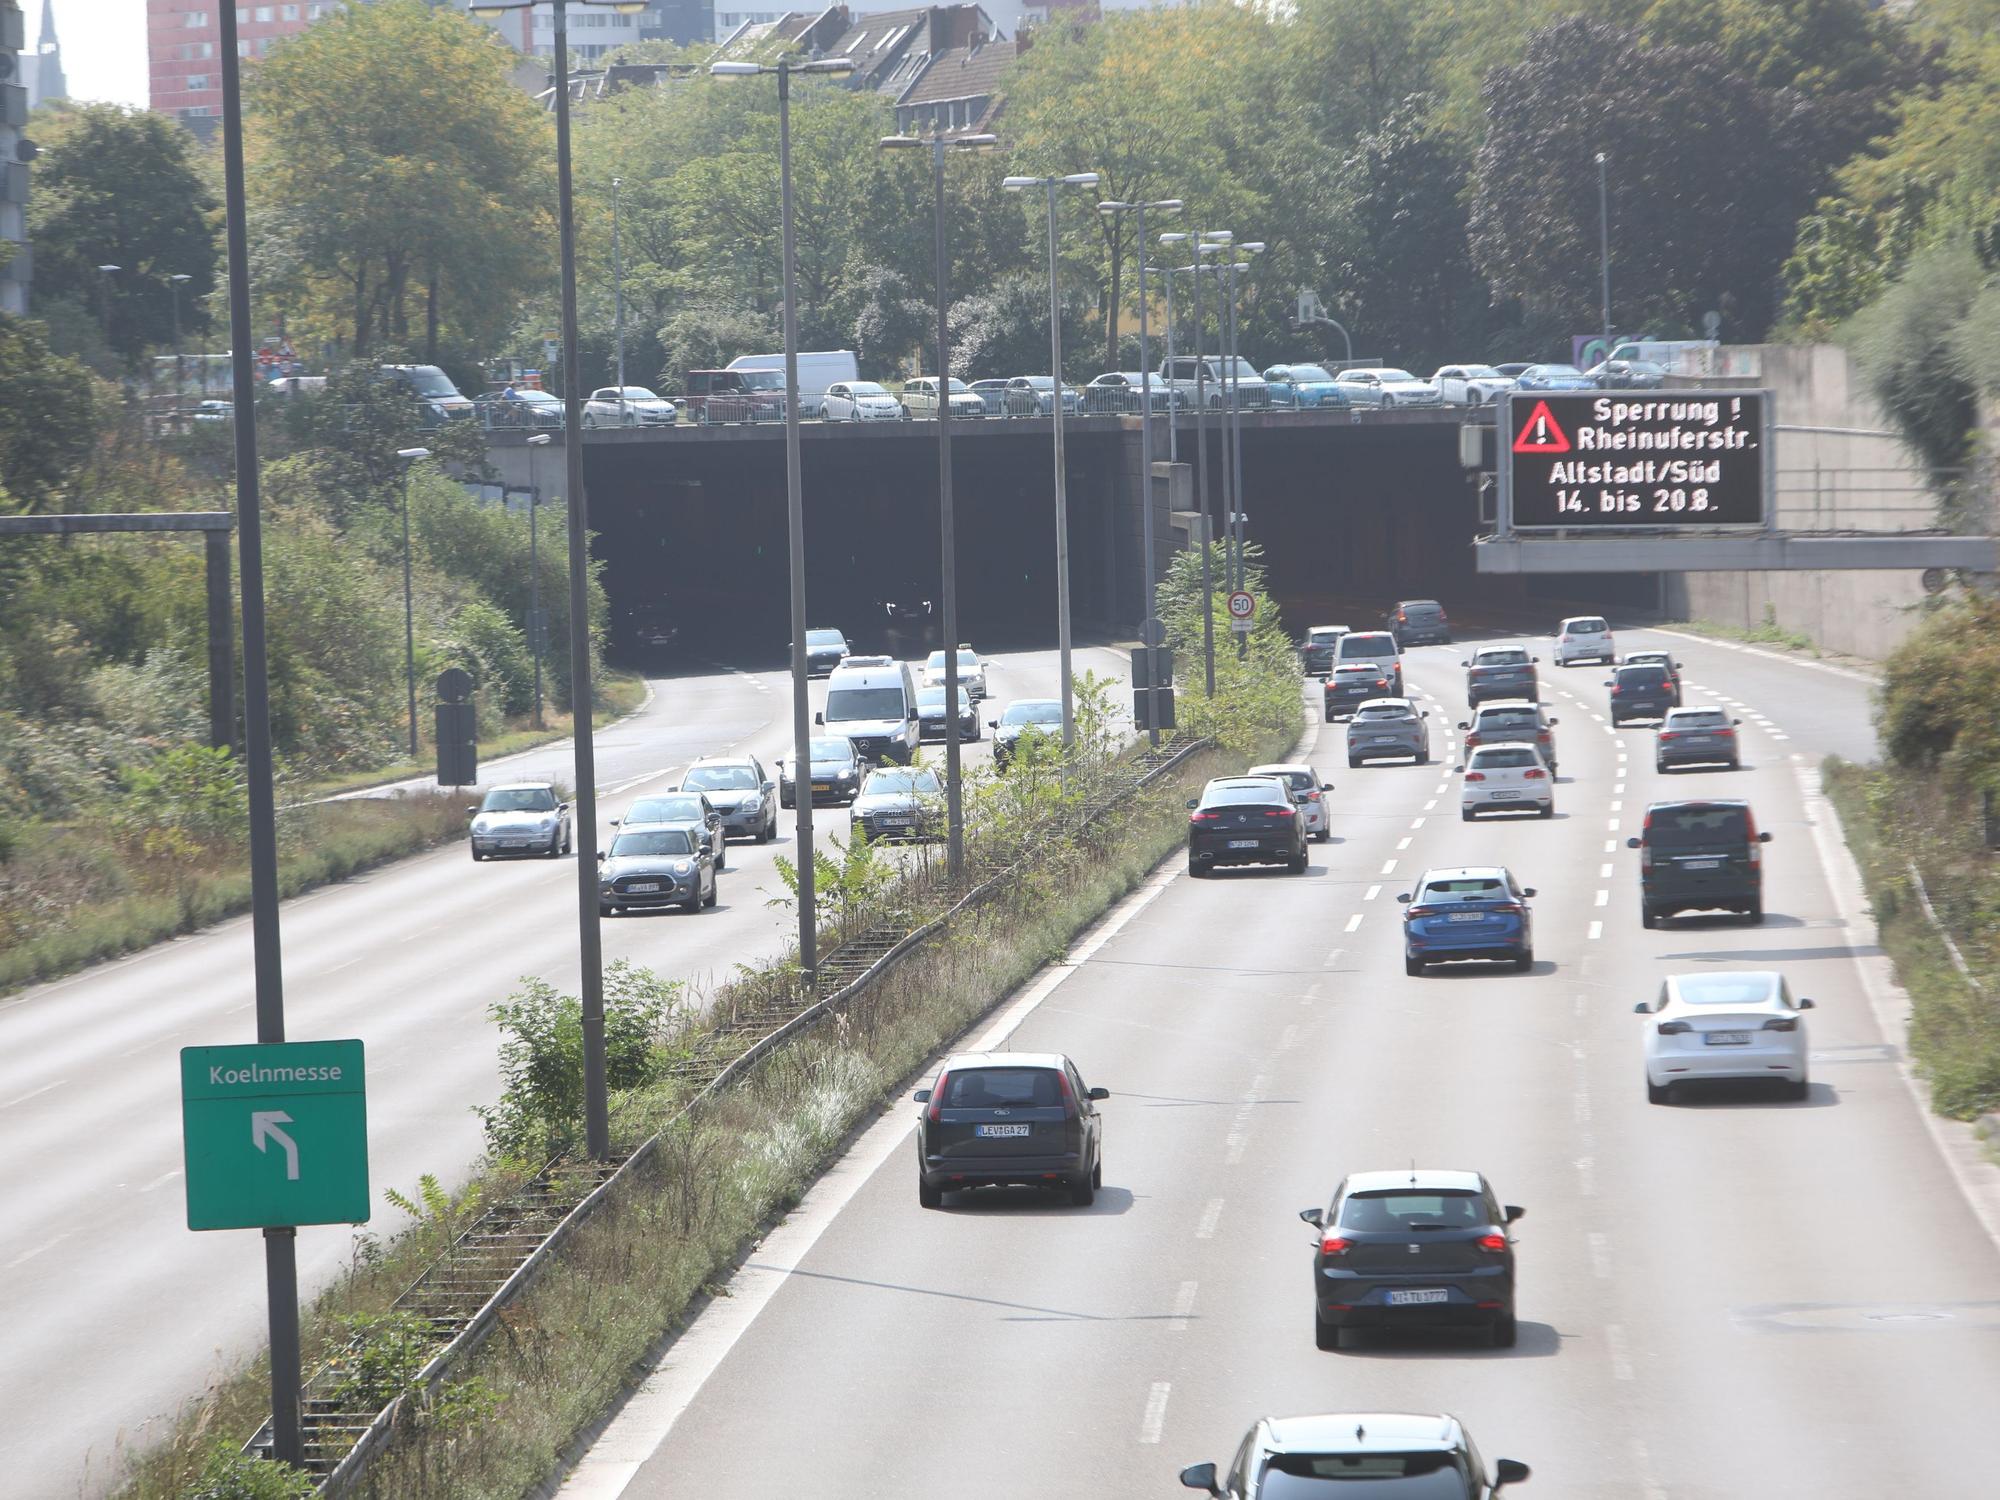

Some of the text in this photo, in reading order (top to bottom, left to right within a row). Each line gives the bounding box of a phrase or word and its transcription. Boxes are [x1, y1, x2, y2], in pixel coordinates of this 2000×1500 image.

[1593, 397, 1741, 426] Sperrung !
[1576, 426, 1758, 450] Rheinuferstr.
[1548, 460, 1721, 484] Altstadt/Süd
[1556, 489, 1590, 513] 14.
[1599, 488, 1641, 512] bis
[1233, 599, 1249, 611] 50
[209, 1063, 342, 1085] Koelnmesse
[982, 1126, 1028, 1135] LEV GA 27
